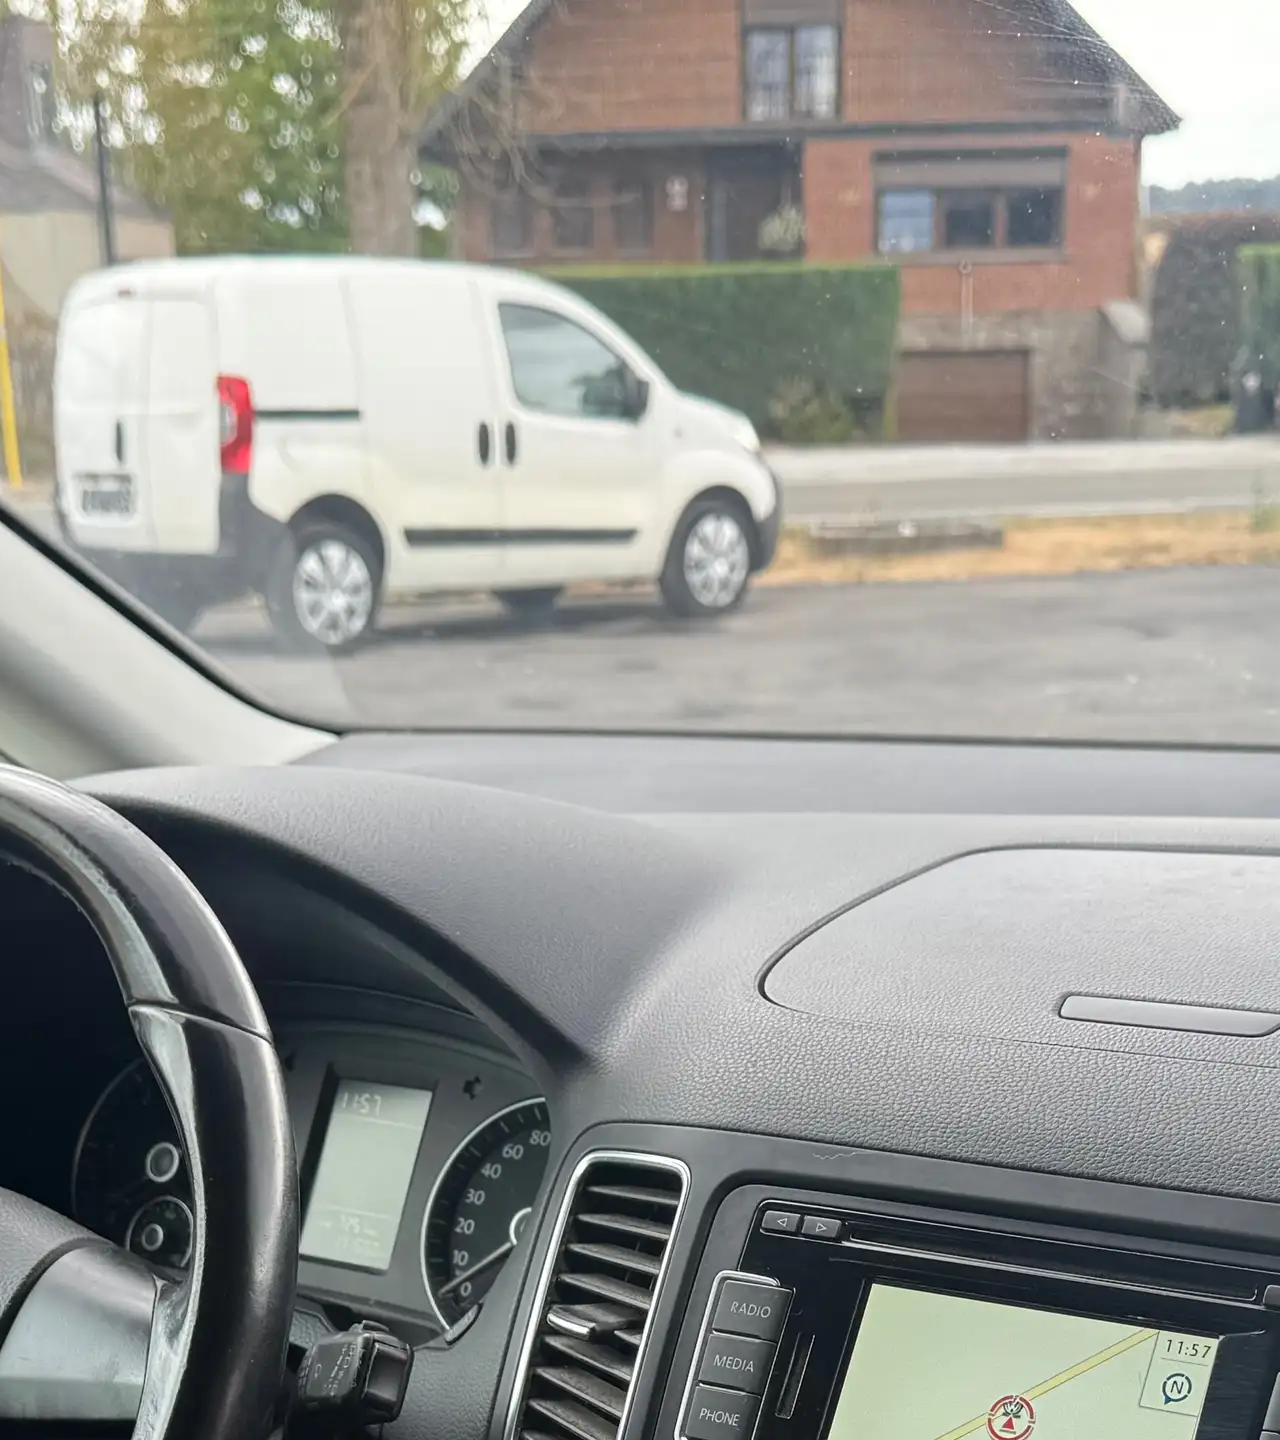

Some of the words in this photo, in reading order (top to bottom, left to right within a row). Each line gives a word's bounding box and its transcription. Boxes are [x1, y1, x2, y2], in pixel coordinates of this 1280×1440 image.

[529, 1129, 551, 1146] 80
[502, 1144, 524, 1160] 60
[480, 1163, 502, 1179] 40
[465, 1188, 486, 1205] 30
[454, 1217, 475, 1235] 20
[452, 1250, 469, 1266] 10
[460, 1281, 472, 1297] 0
[730, 1301, 771, 1318] RADIO
[1166, 1339, 1212, 1359] 11:57
[713, 1354, 754, 1373] MEDIA
[1170, 1380, 1184, 1394] N
[699, 1407, 740, 1426] PHONE
